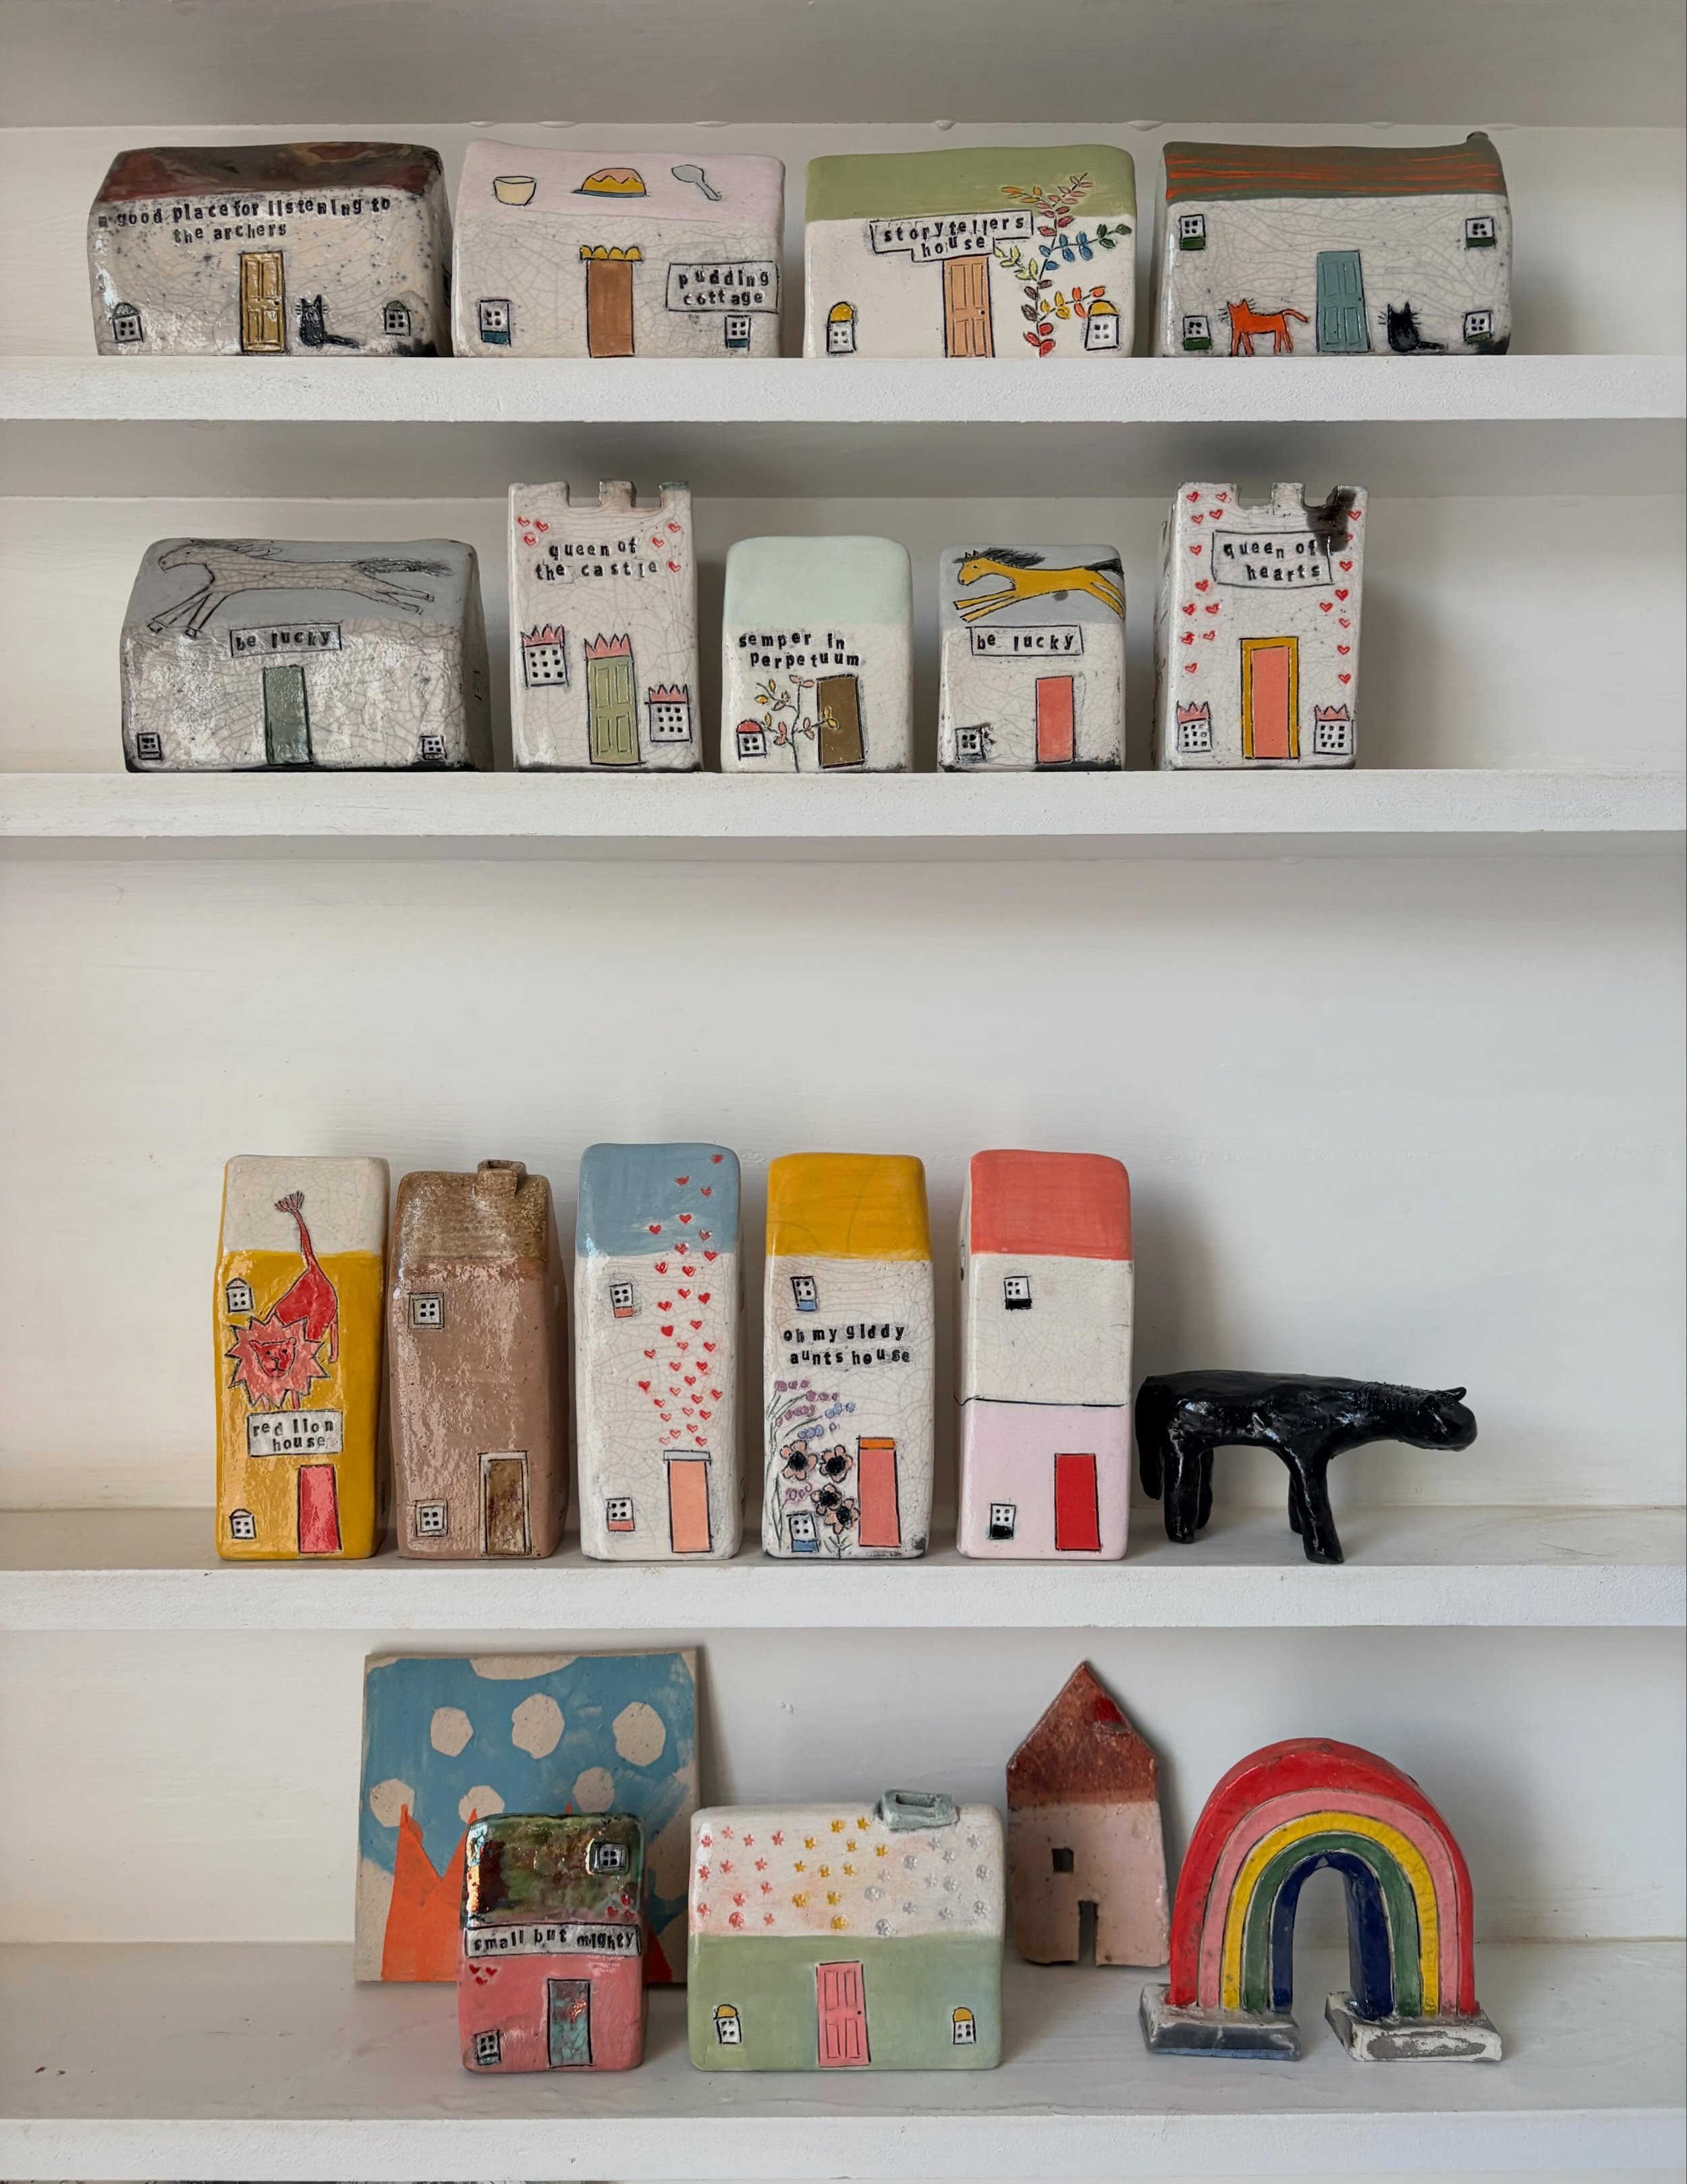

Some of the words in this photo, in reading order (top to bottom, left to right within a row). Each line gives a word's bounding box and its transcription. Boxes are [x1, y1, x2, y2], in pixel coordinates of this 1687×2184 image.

[117, 208, 162, 227] good
[173, 203, 229, 223] place
[234, 200, 259, 217] for
[269, 198, 362, 216] listening
[372, 198, 390, 212] to
[173, 227, 203, 244] the
[214, 224, 286, 240] archers
[884, 217, 1024, 242] storytellers
[921, 236, 985, 258] house
[679, 270, 769, 289] pudding
[684, 290, 763, 306] cottage
[549, 544, 610, 561] queen
[617, 536, 636, 554] of
[1223, 542, 1284, 559] queen
[1296, 540, 1316, 555] of
[536, 563, 565, 581] the
[581, 561, 657, 578] castle
[1246, 565, 1320, 582] hearts
[237, 636, 256, 650] be
[272, 631, 331, 648] lucky
[739, 632, 812, 650] semper
[827, 633, 845, 650] in
[977, 634, 996, 650] be
[1014, 635, 1074, 651] lucky
[750, 652, 860, 669] perpetuum
[783, 1328, 805, 1343] oh
[812, 1328, 837, 1343] my
[846, 1324, 904, 1341] giddy
[790, 1350, 844, 1365] aunts
[852, 1349, 910, 1365] house
[253, 1422, 283, 1436] red
[293, 1418, 334, 1433] lion
[273, 1436, 325, 1452] house
[474, 1930, 524, 1951] small
[534, 1928, 567, 1945] but
[577, 1931, 634, 1950] mighty
